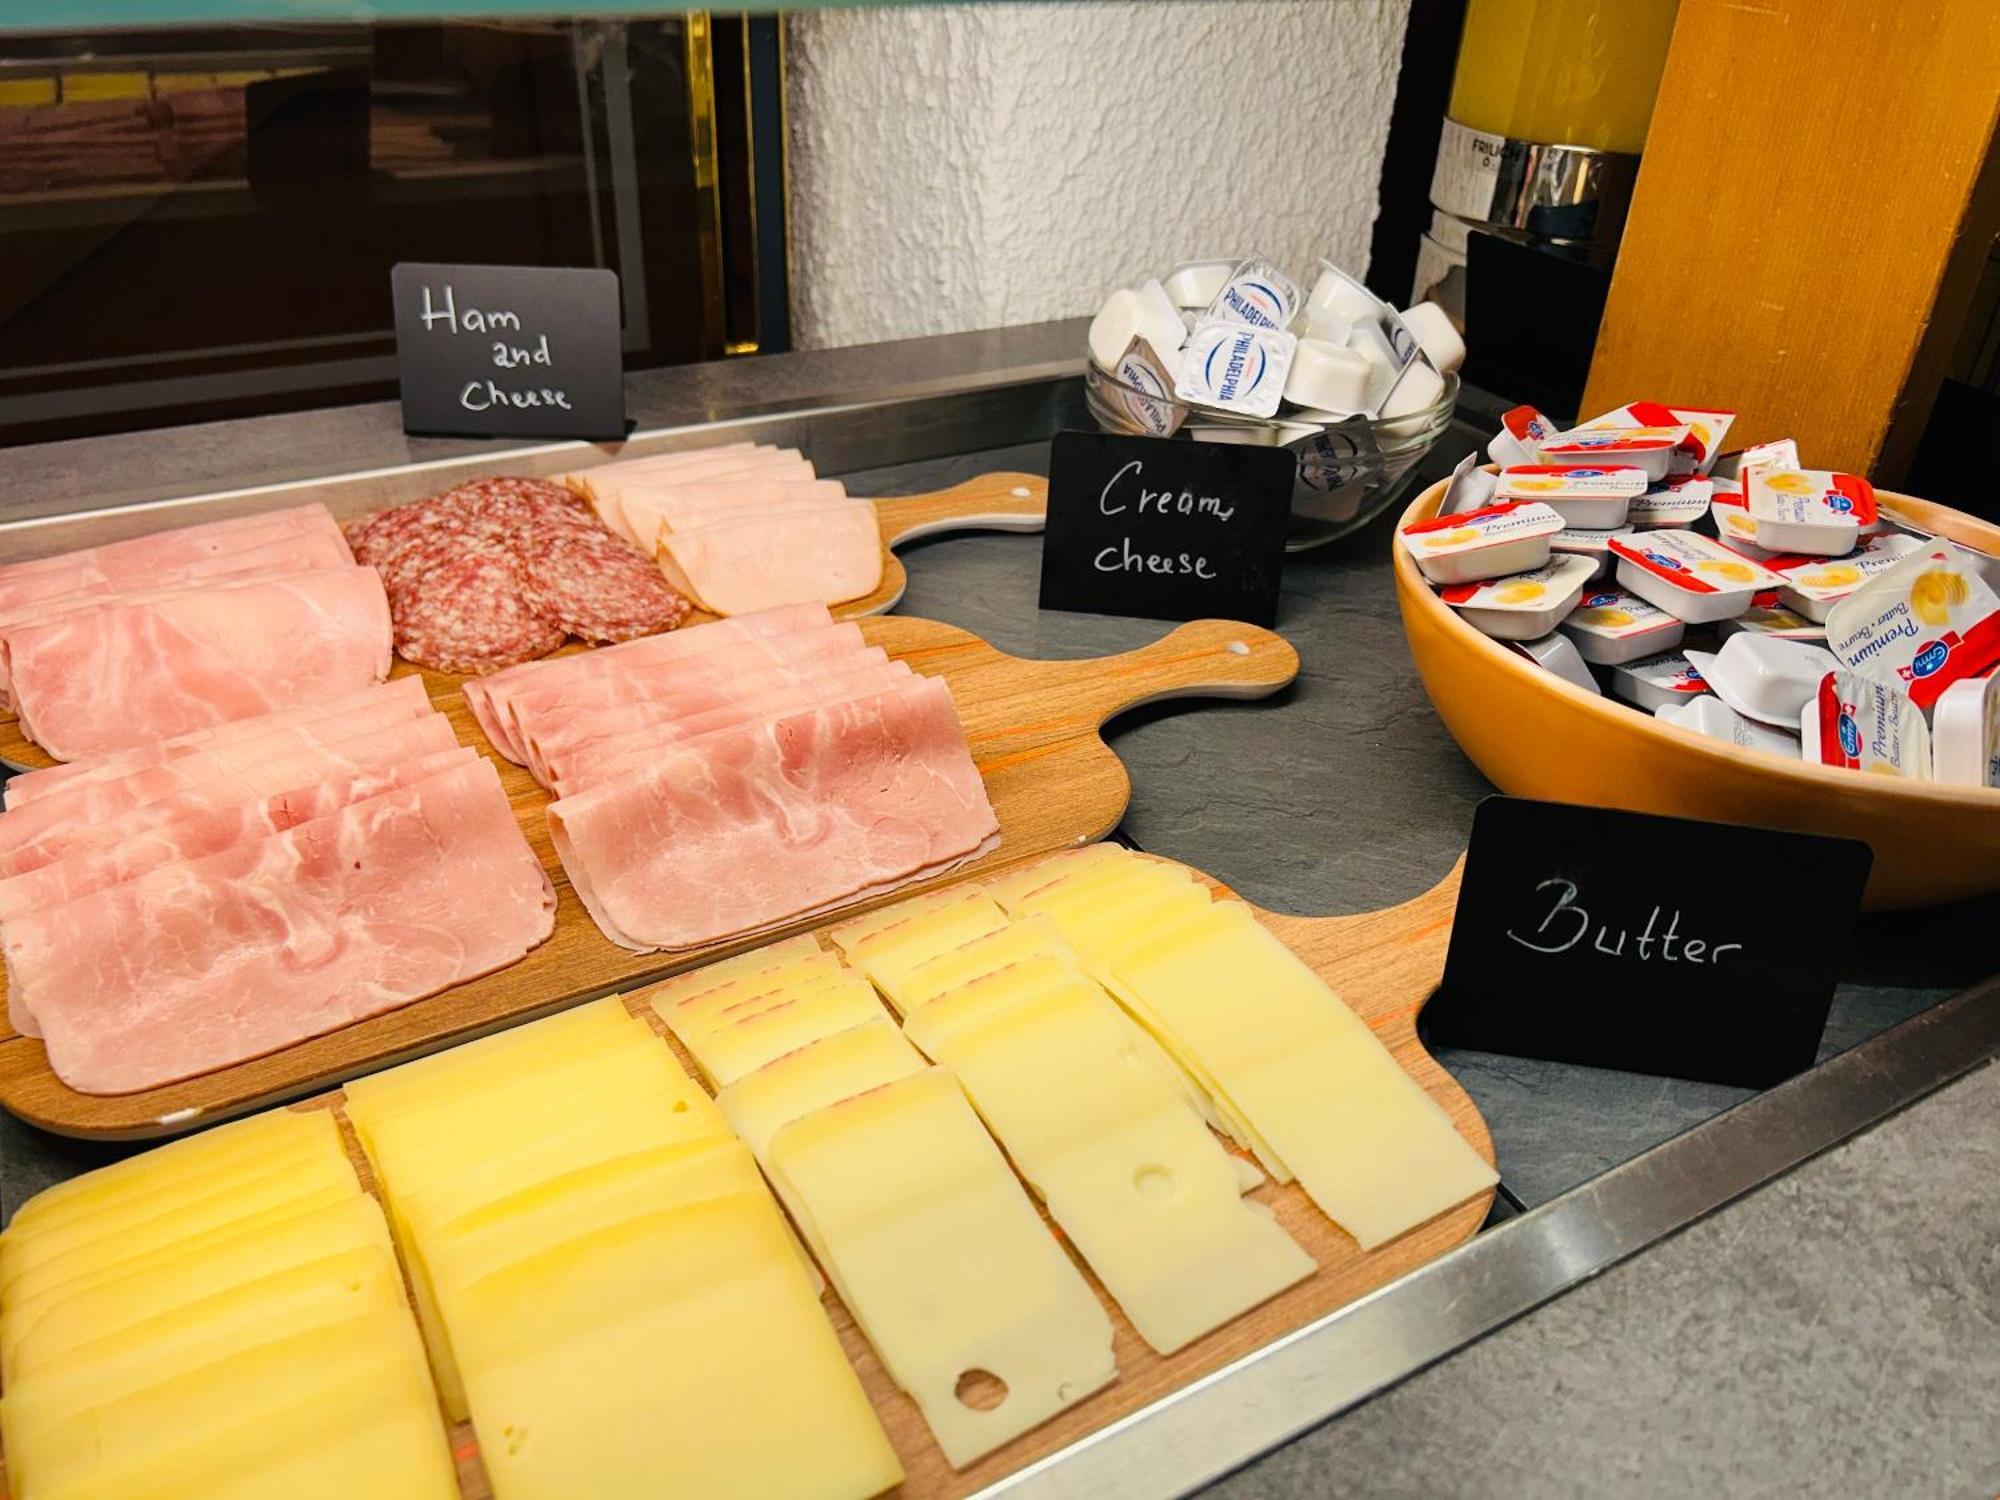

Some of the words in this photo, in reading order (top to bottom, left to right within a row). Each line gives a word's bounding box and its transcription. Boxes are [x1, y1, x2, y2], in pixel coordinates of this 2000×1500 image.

[421, 286, 521, 334] Ham
[493, 334, 552, 369] and
[1218, 331, 1255, 401] PHILADELPHIA
[460, 379, 572, 411] Cheese
[1100, 460, 1235, 522] Cream
[1094, 537, 1217, 579] cheese
[1872, 683, 1888, 758] Premium
[1507, 878, 1743, 963] Butter
